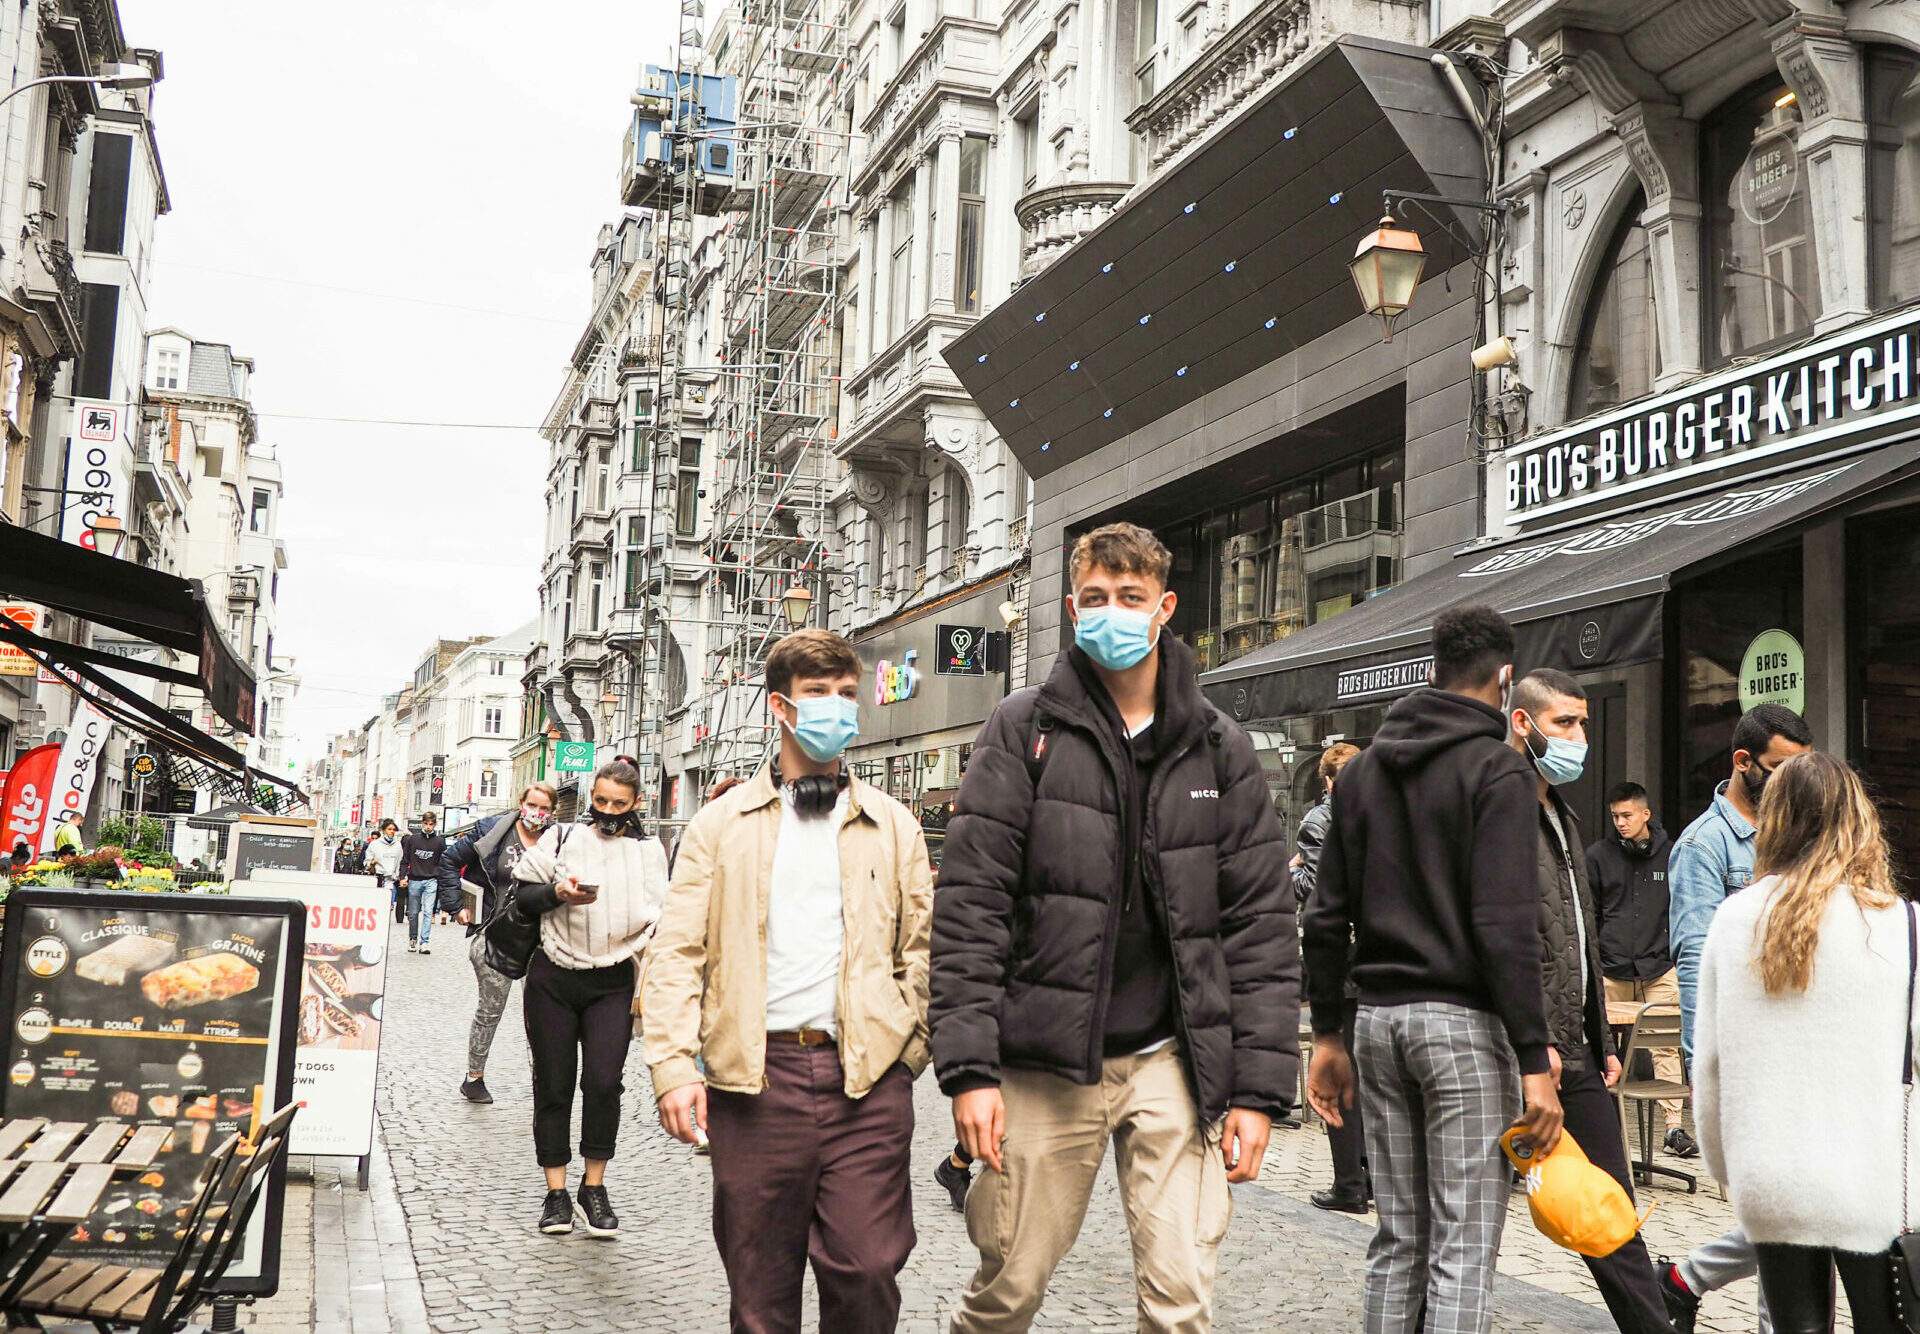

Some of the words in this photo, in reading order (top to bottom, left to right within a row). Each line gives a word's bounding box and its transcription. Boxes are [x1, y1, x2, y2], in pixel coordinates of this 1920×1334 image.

[1755, 150, 1781, 172] BRO'S
[1750, 163, 1788, 192] BURGER
[84, 429, 111, 439] DELHAIZE
[1600, 383, 1755, 484] BURGER
[1756, 652, 1788, 672] BRO'S
[1363, 667, 1400, 690] BURGER
[1749, 672, 1797, 696] BURGER
[135, 764, 152, 772] PASTA
[561, 755, 589, 767] PEARLE
[102, 917, 126, 926] TACOS
[327, 906, 378, 931] DOGS
[80, 924, 150, 943] CLASSIQUE
[231, 933, 256, 945] TACOS
[32, 949, 62, 959] STYLE
[211, 939, 266, 964] GRATINÉ
[34, 993, 43, 1003] 2
[58, 1018, 93, 1028] SIMPLE
[103, 1021, 143, 1031] DOUBLE
[158, 1024, 185, 1033] MAXI
[203, 1027, 240, 1037] XTREME
[306, 1063, 335, 1071] DOGS
